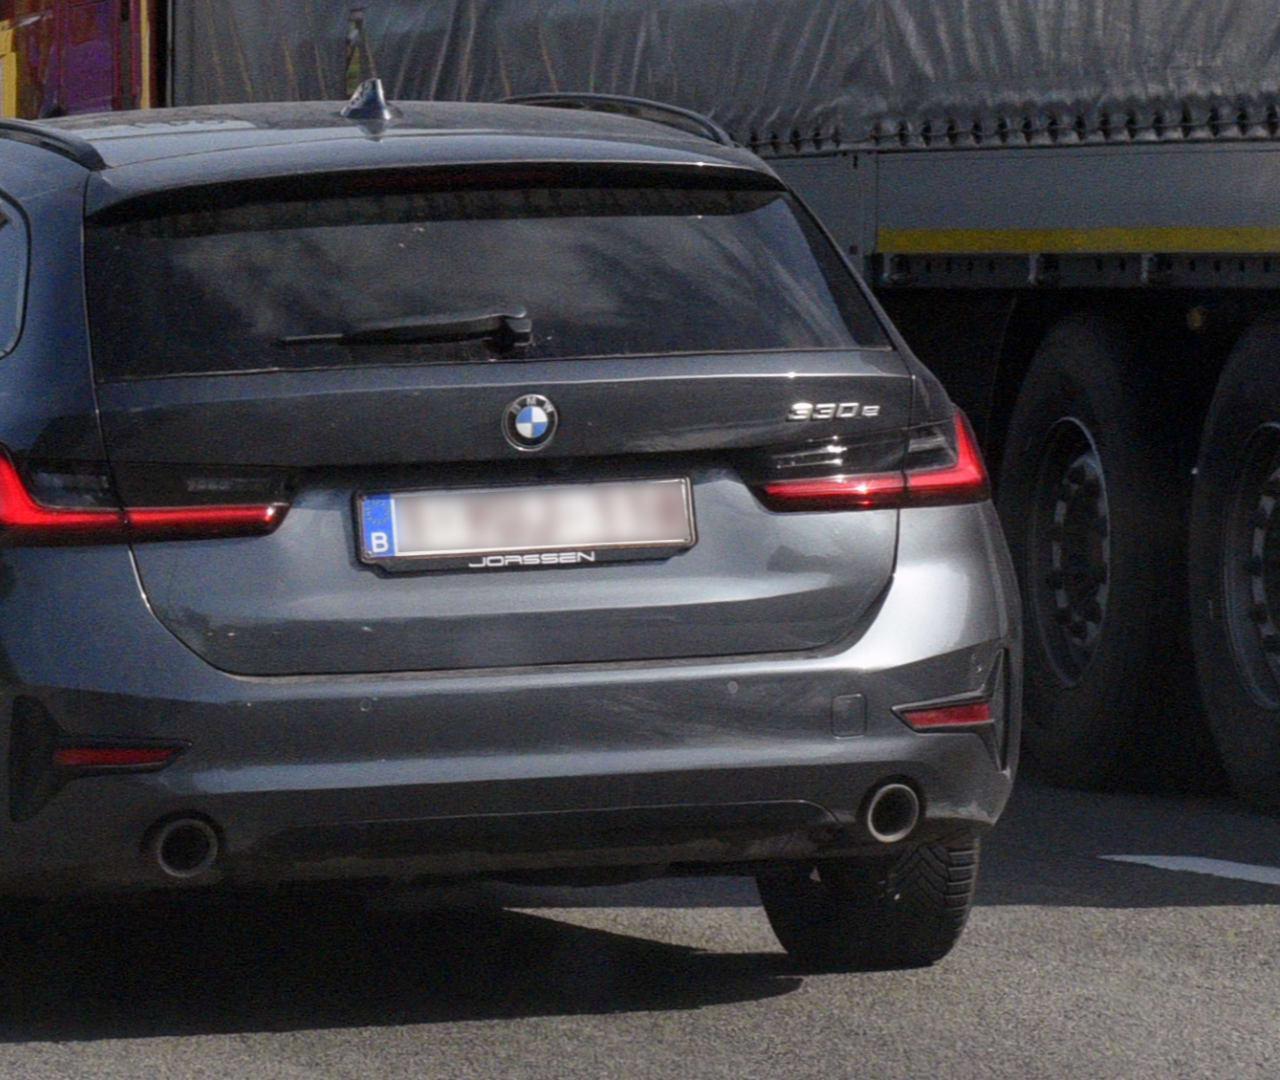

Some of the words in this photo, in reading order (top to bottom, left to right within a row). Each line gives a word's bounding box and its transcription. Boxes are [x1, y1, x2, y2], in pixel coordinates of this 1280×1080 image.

[788, 402, 881, 420] 330e
[371, 532, 389, 553] B
[468, 550, 596, 568] JORSSEN
